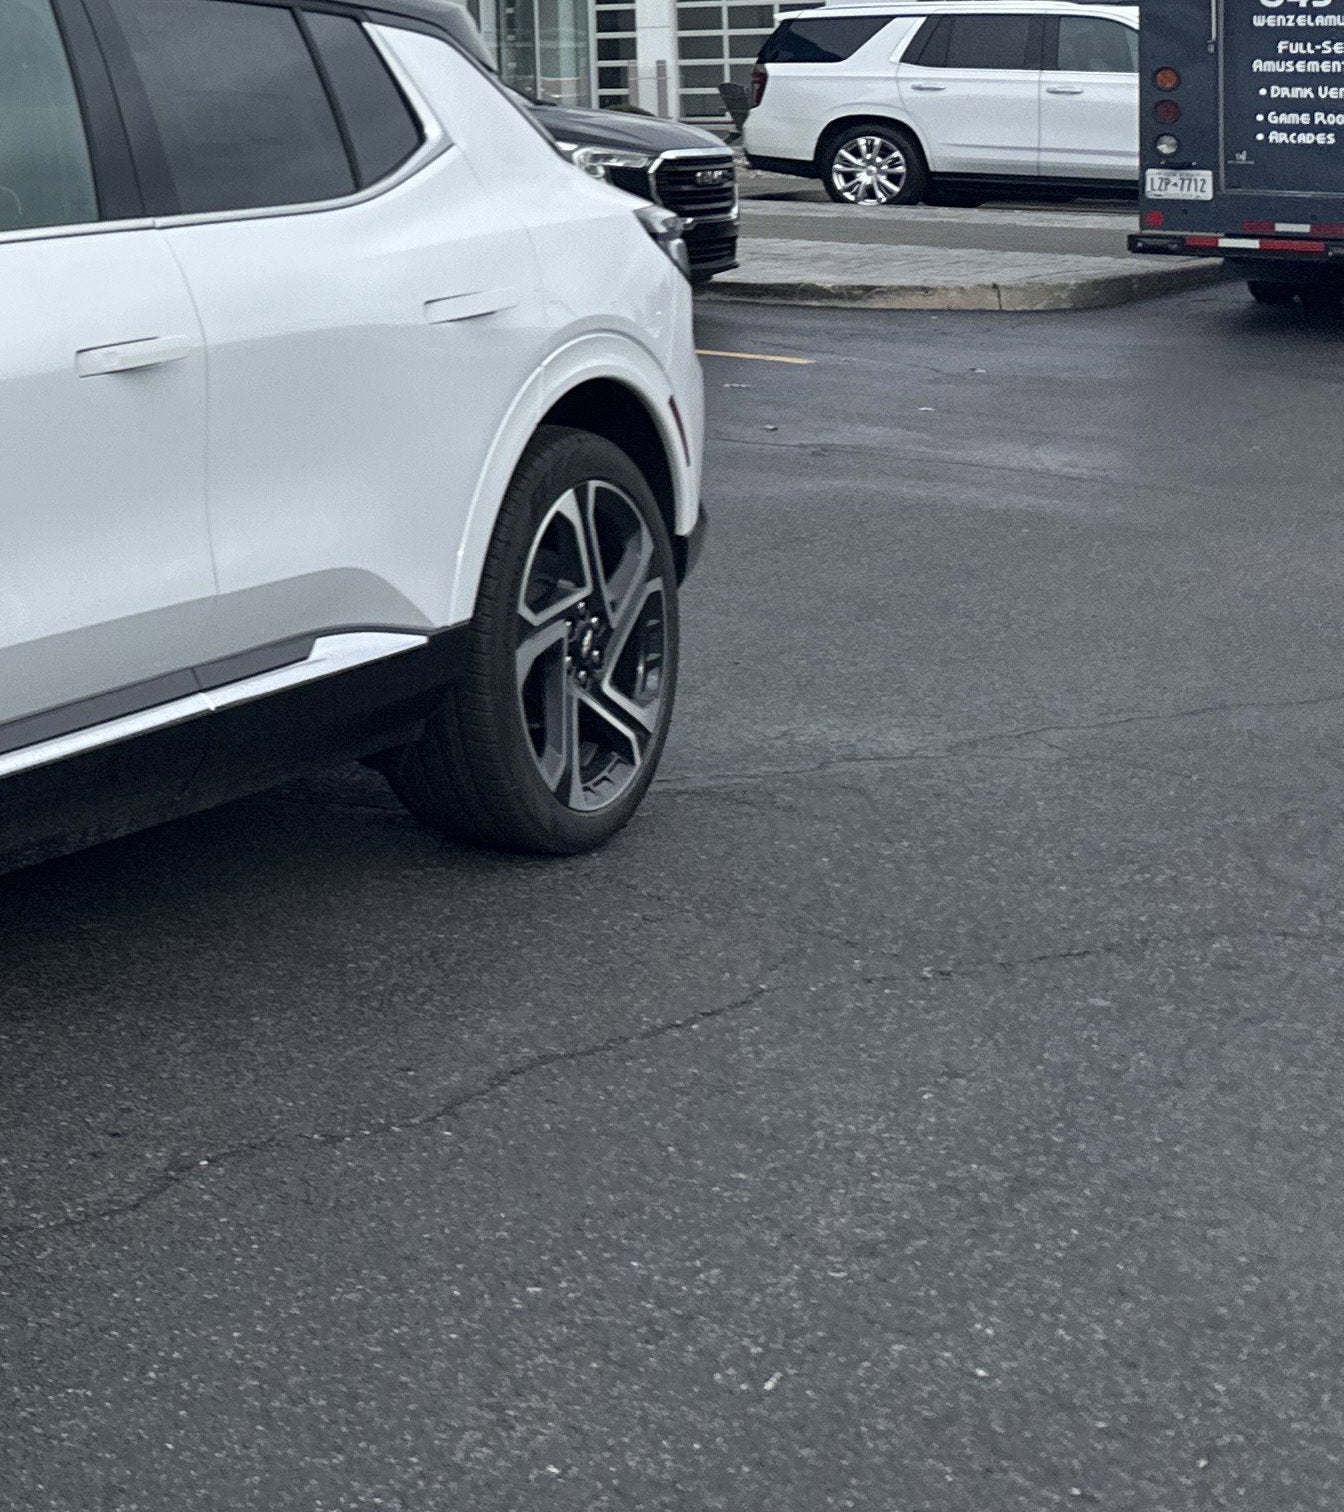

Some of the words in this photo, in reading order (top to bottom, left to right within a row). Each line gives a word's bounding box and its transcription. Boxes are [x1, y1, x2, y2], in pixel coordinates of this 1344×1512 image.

[1252, 59, 1344, 72] AMUSEMEN
[1270, 85, 1315, 99] DRINK
[1267, 111, 1311, 125] GAME
[1268, 131, 1336, 144] ARCADES
